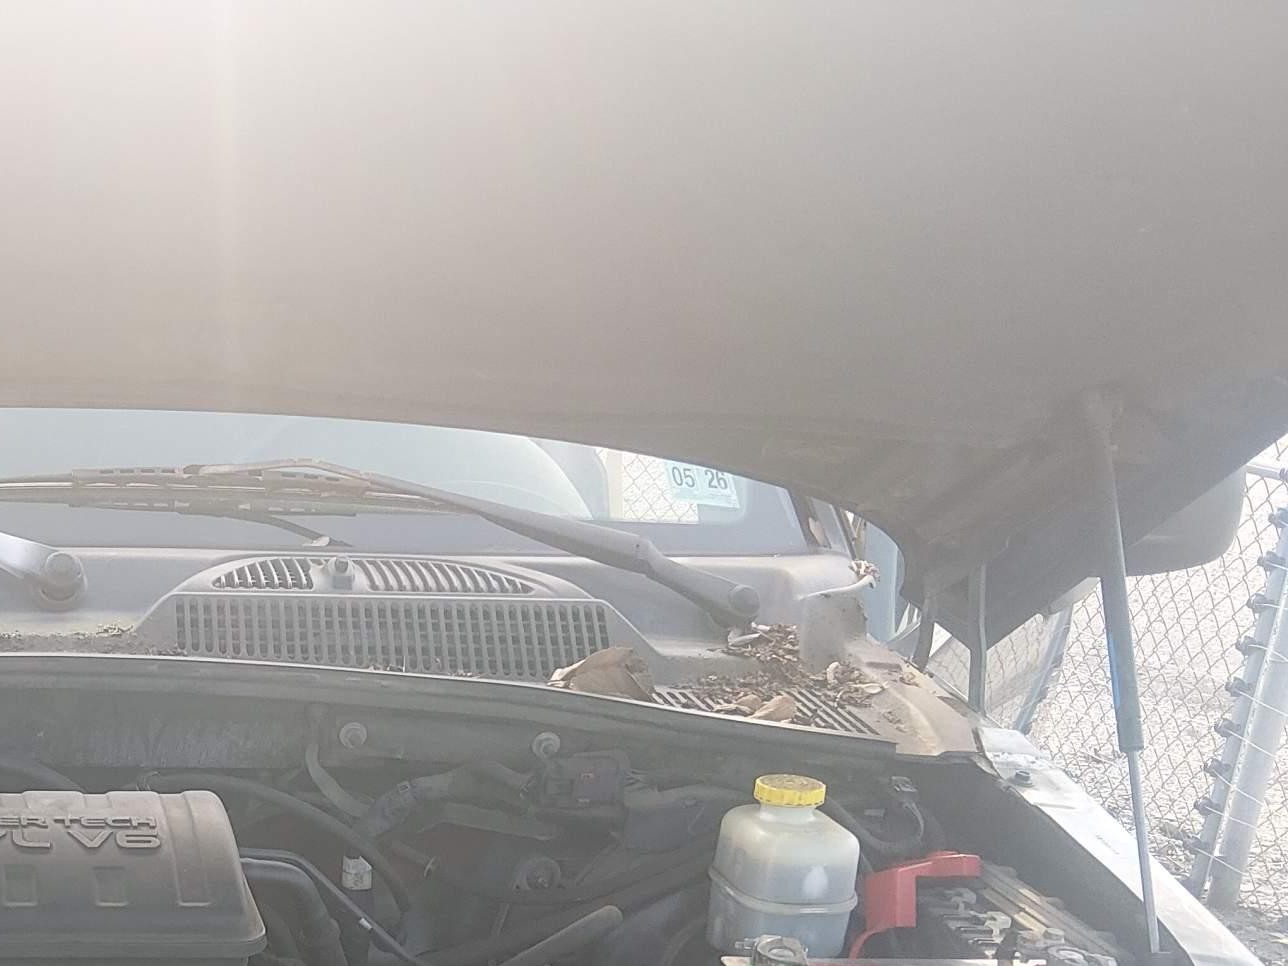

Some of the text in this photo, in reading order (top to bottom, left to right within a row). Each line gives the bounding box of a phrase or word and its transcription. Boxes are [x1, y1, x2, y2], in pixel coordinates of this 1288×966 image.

[672, 466, 728, 490] 05 26
[52, 816, 157, 829] TECH
[67, 828, 162, 850] V6
